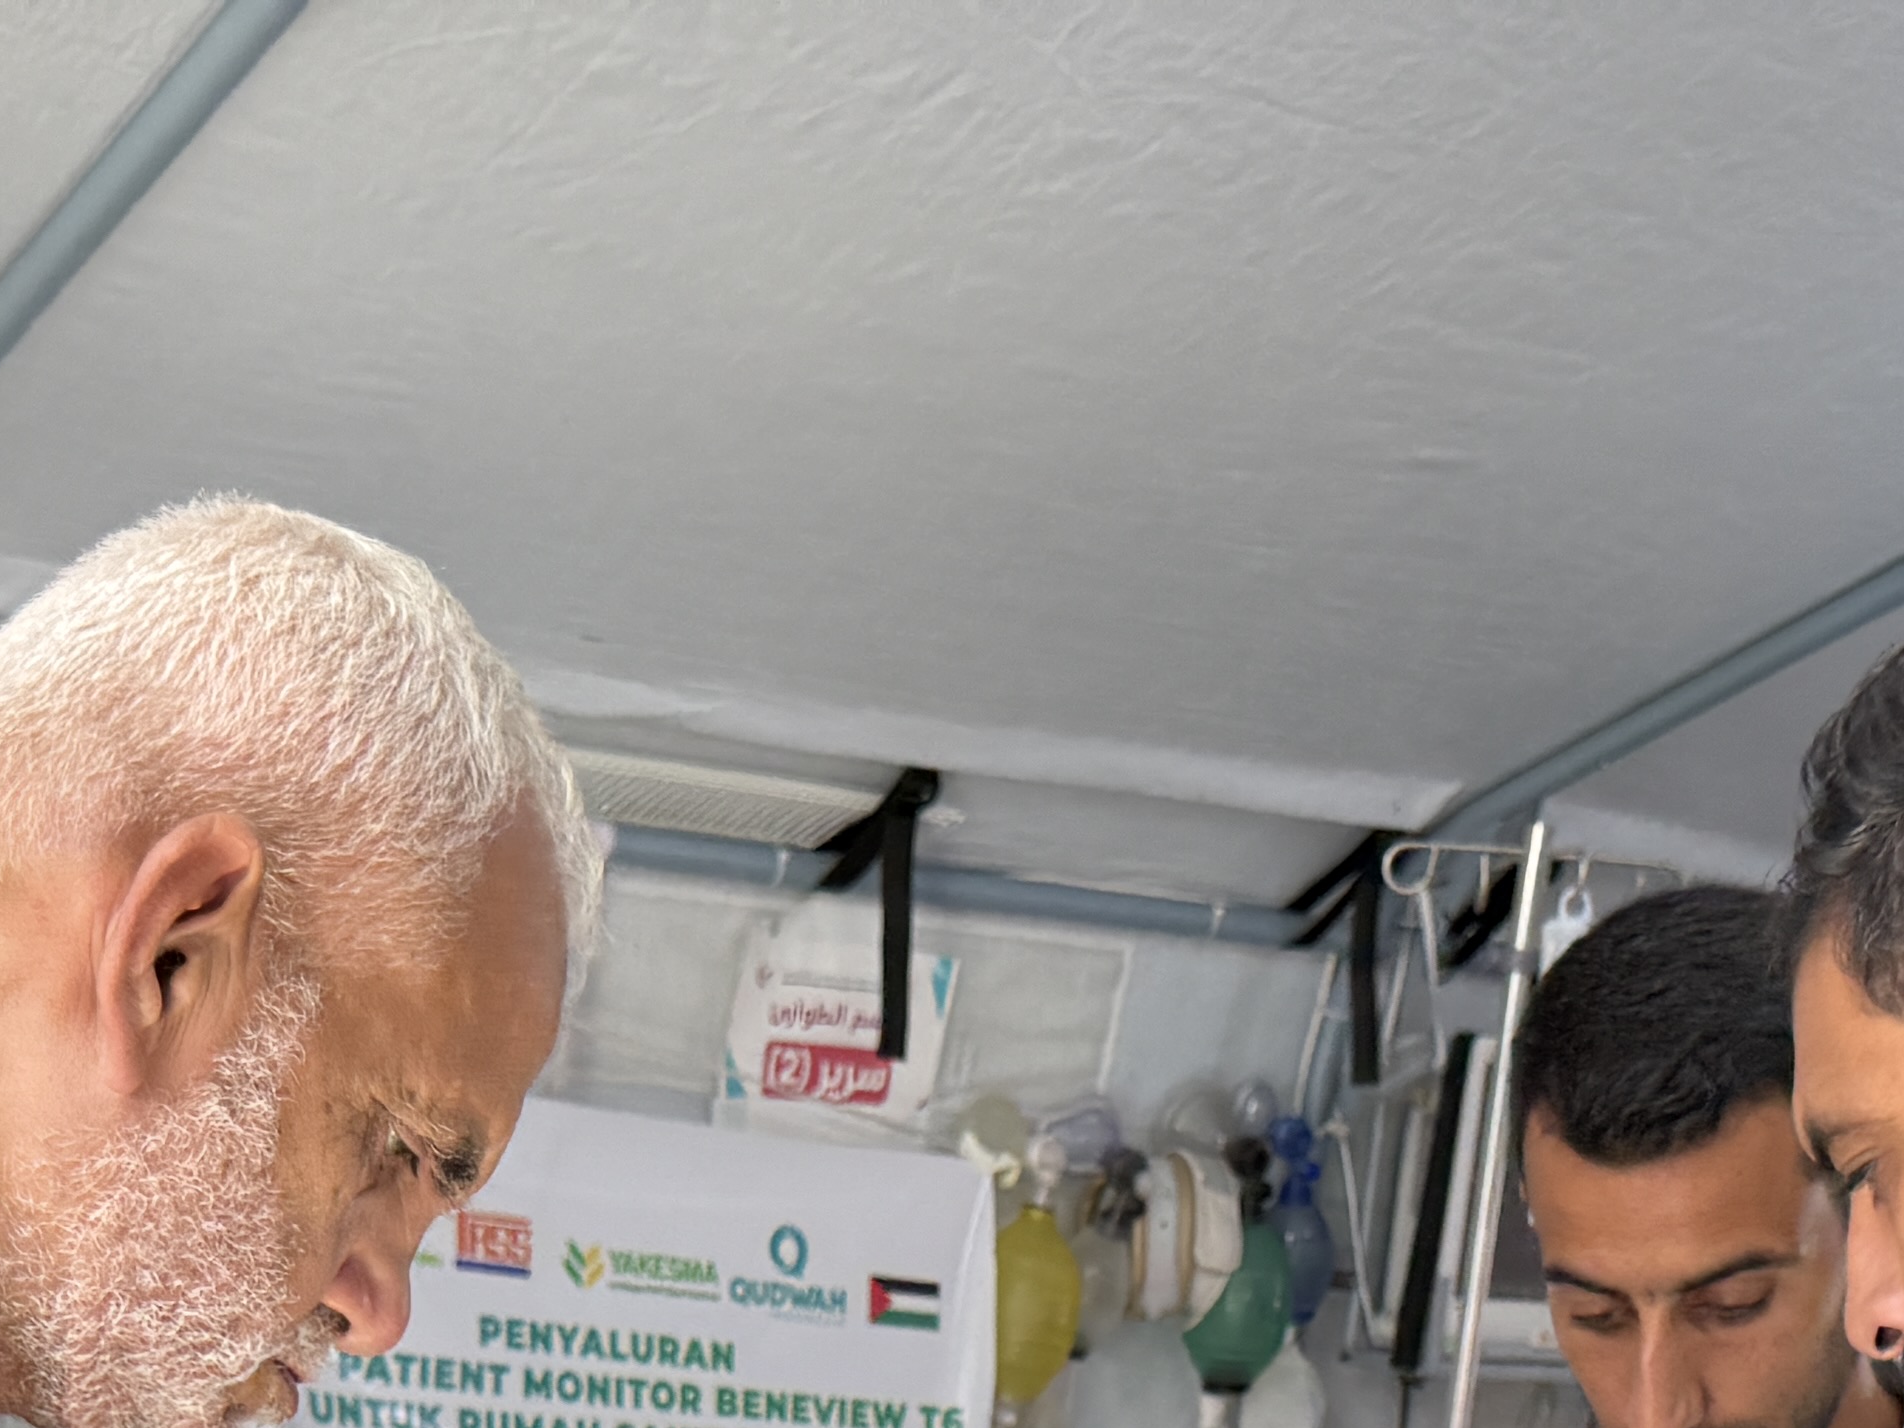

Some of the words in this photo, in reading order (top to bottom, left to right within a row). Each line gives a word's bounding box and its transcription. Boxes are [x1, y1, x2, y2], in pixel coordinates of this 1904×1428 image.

[766, 1046, 812, 1095] (2)
[816, 1058, 887, 1105] سرير
[729, 1276, 848, 1313] QUDWAH
[479, 1314, 736, 1373] PENYALURAN
[338, 1351, 511, 1397] PATIENT
[523, 1367, 703, 1415] MONITOR
